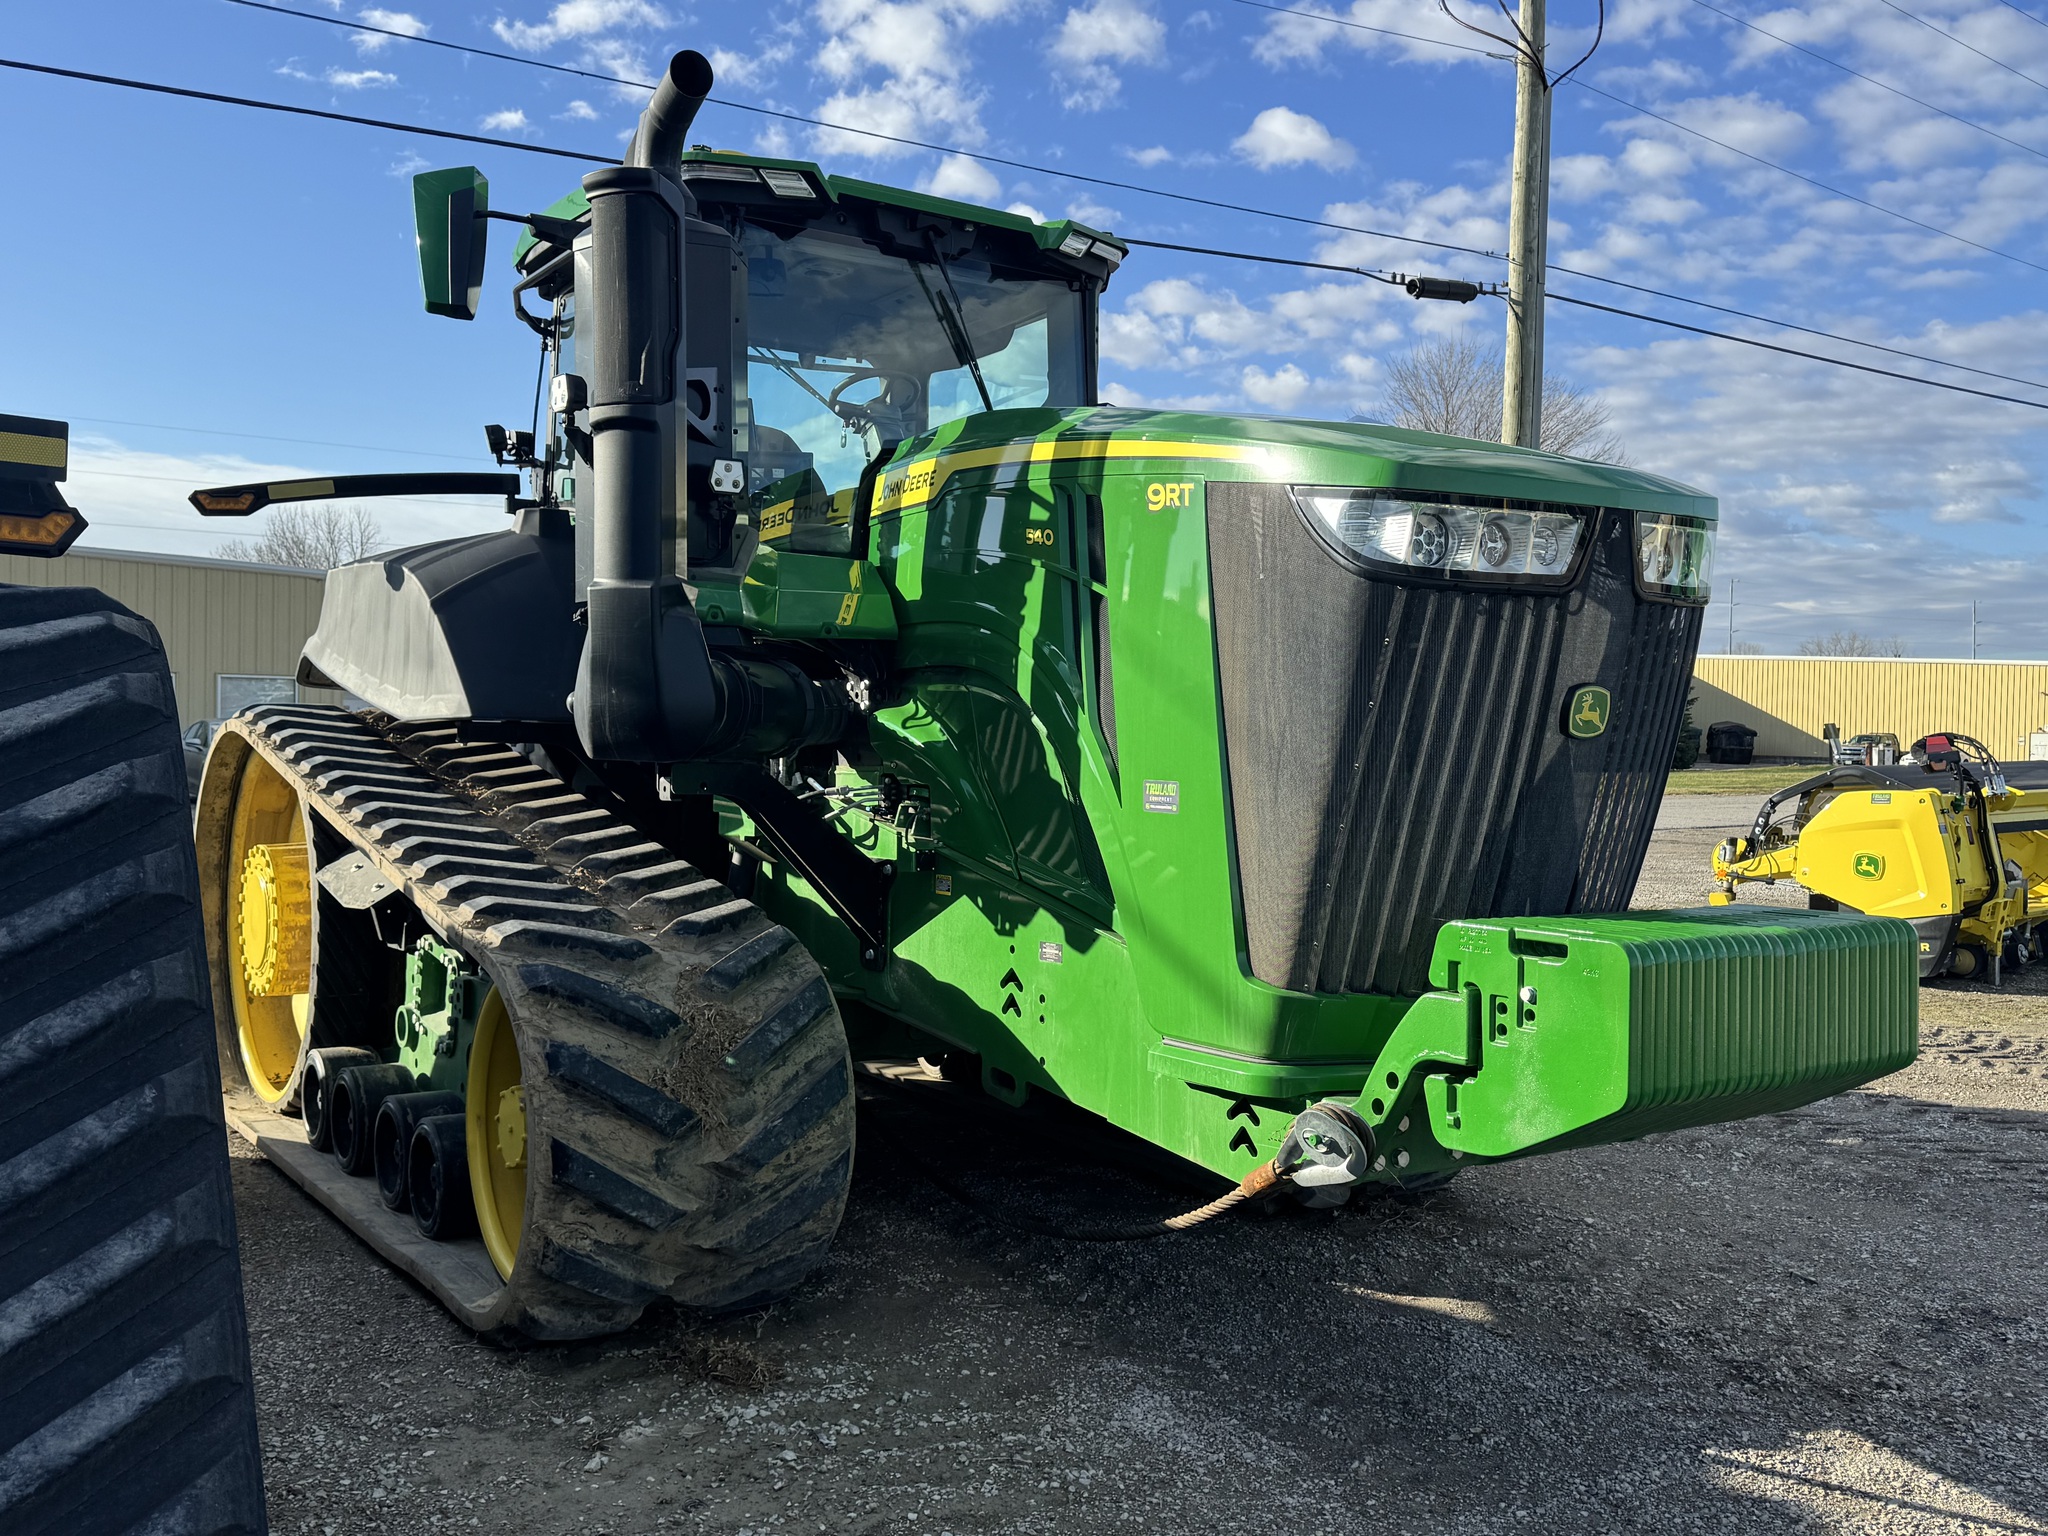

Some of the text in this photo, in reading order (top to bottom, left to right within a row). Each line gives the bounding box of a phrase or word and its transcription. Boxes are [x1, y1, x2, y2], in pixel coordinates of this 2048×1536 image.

[878, 469, 937, 502] JOHN DEERE
[1146, 482, 1195, 512] 9RT
[1025, 528, 1055, 546] 540
